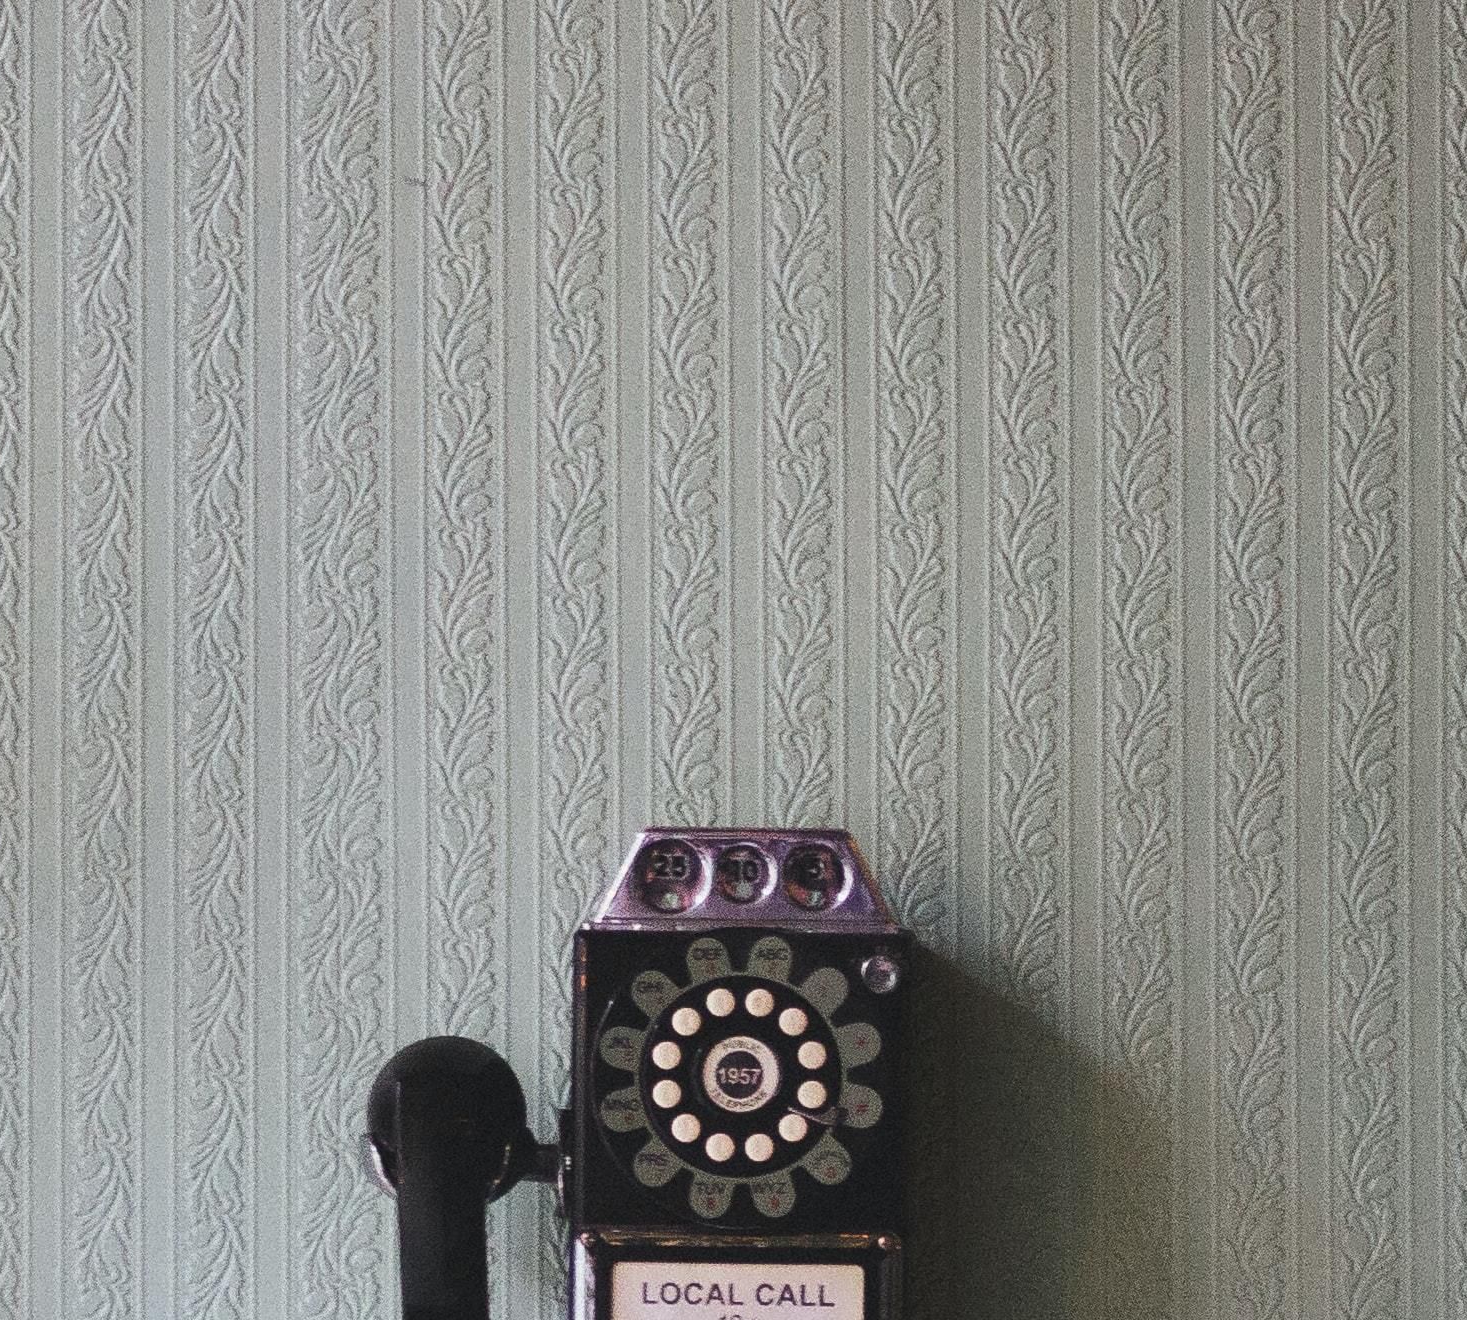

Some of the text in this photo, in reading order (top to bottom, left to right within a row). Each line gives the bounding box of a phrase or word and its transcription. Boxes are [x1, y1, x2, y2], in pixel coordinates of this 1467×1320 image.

[653, 855, 687, 877] 25
[732, 858, 759, 881] 10
[718, 1067, 762, 1085] 1957
[642, 1282, 835, 1307] LOCAL CALL
